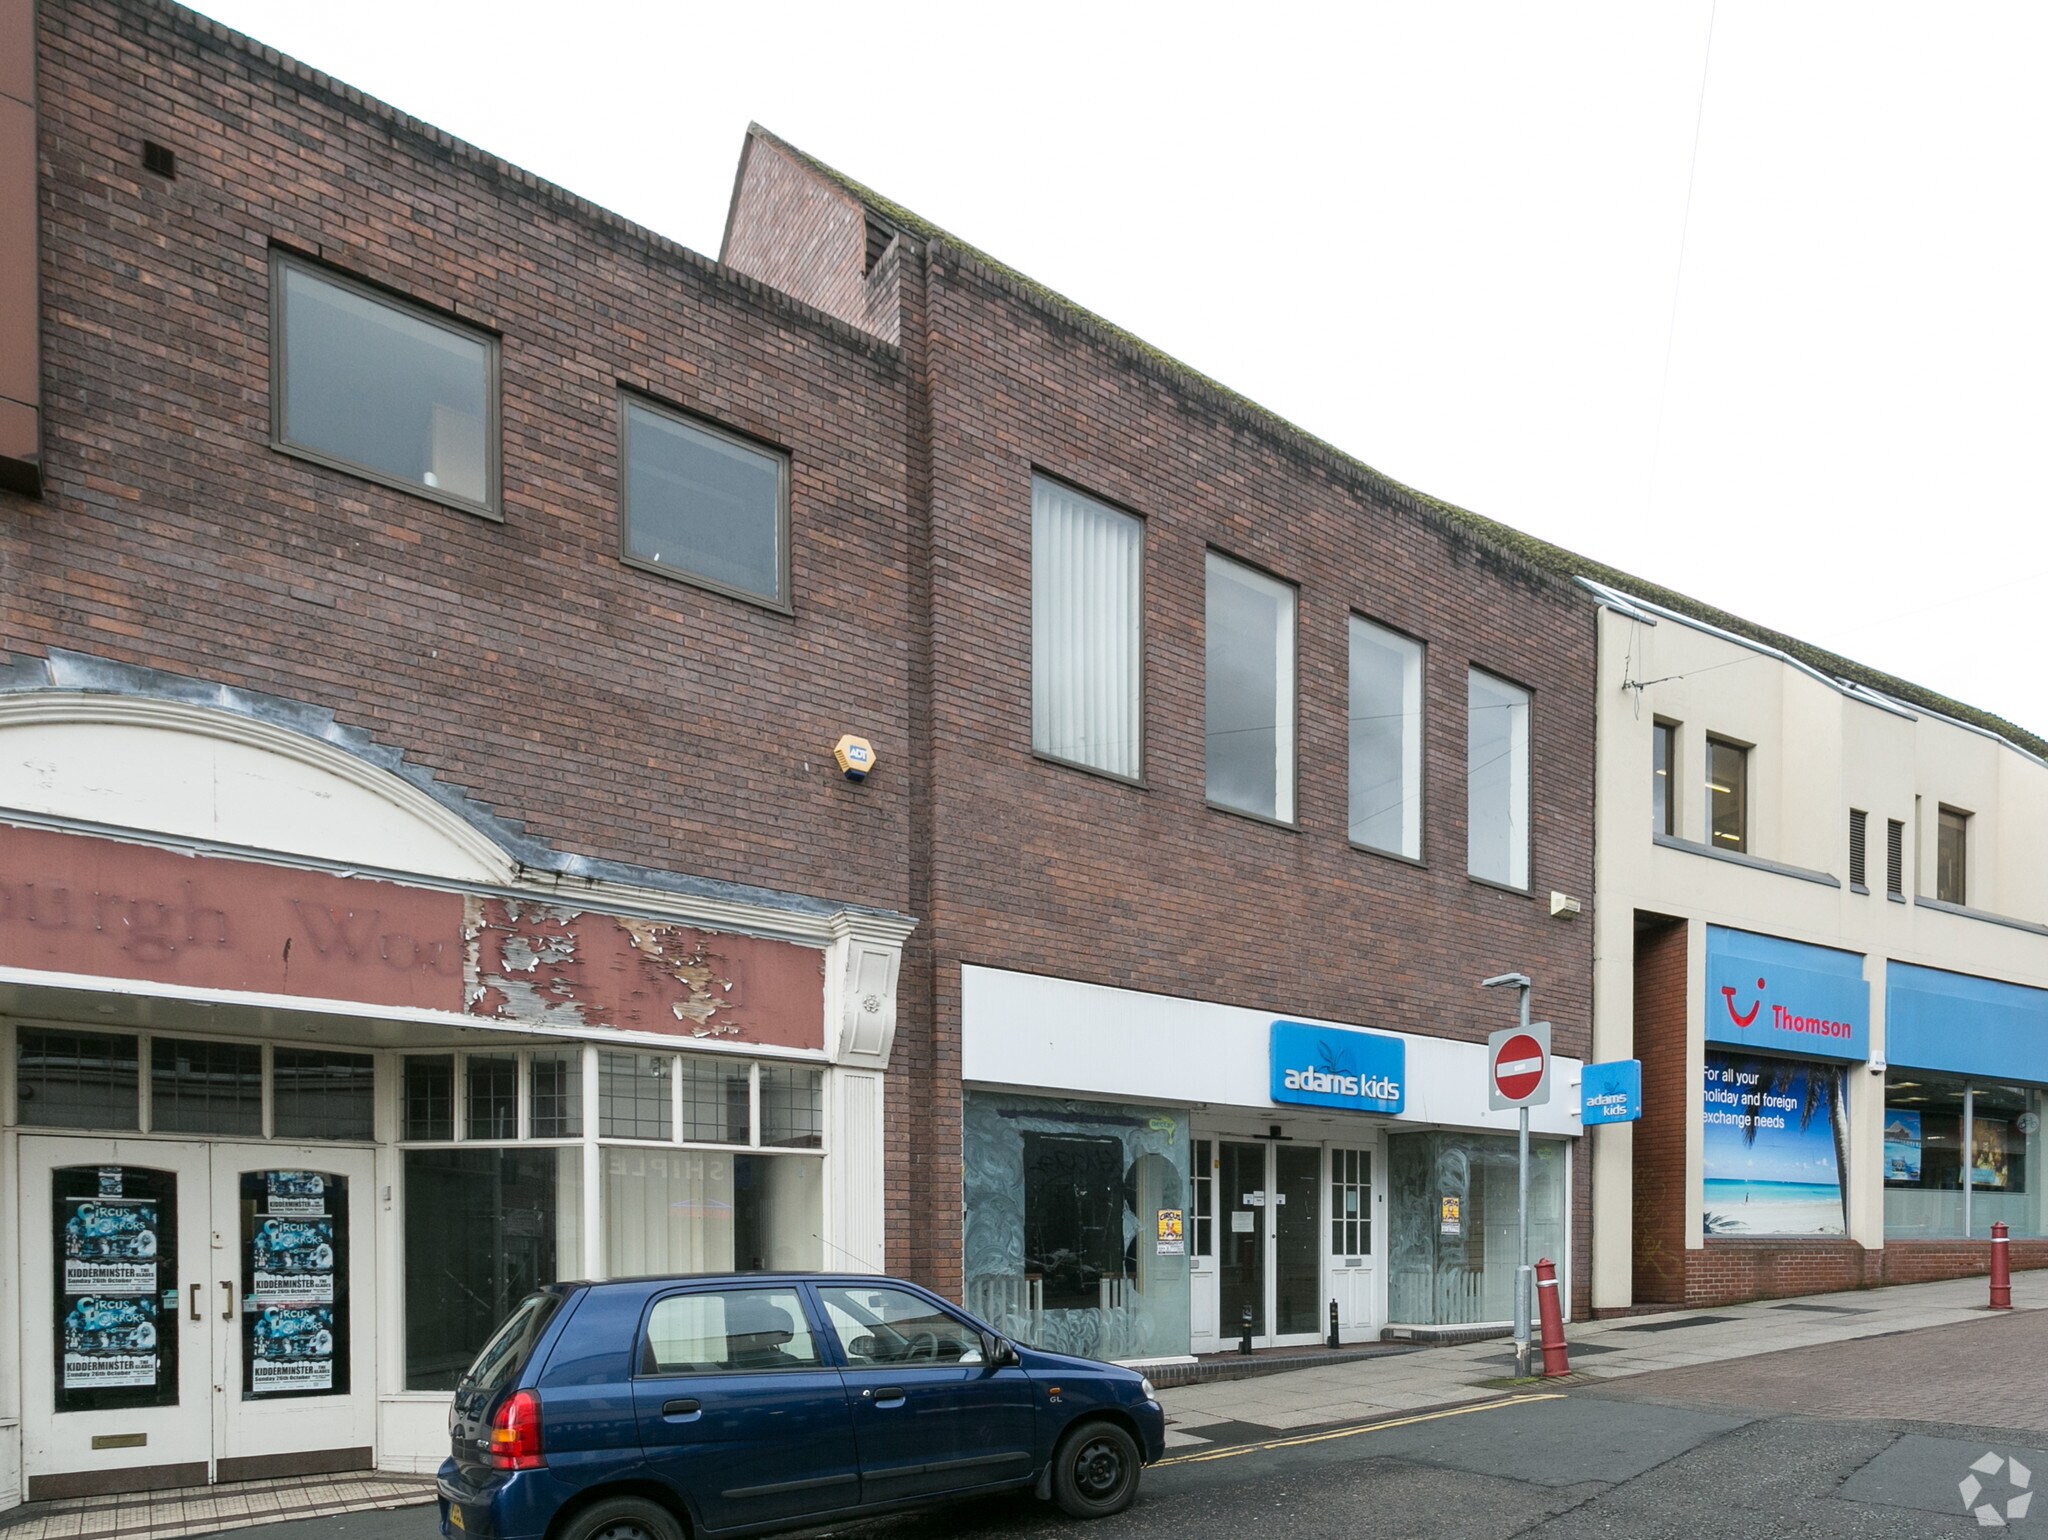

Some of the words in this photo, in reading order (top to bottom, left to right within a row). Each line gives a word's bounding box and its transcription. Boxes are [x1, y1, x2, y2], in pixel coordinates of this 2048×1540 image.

[1772, 1004, 1851, 1039] Thomson
[1284, 1065, 1358, 1096] adams
[1361, 1073, 1399, 1100] kids
[1722, 1068, 1734, 1083] all
[1736, 1072, 1759, 1086] your
[1586, 1094, 1627, 1107] adams
[1741, 1092, 1761, 1106] and
[1763, 1093, 1797, 1112] foreign
[1603, 1104, 1627, 1116] kids
[1703, 1110, 1751, 1129] exchange
[1754, 1115, 1785, 1129] needs
[67, 1268, 135, 1278] KIDDERMINSTER
[256, 1279, 315, 1288] KIDDERMINSTER
[66, 1360, 135, 1372] KIDDERMINSTER
[254, 1366, 313, 1376] KIDDERMINSTER
[1049, 1396, 1063, 1404] GL
